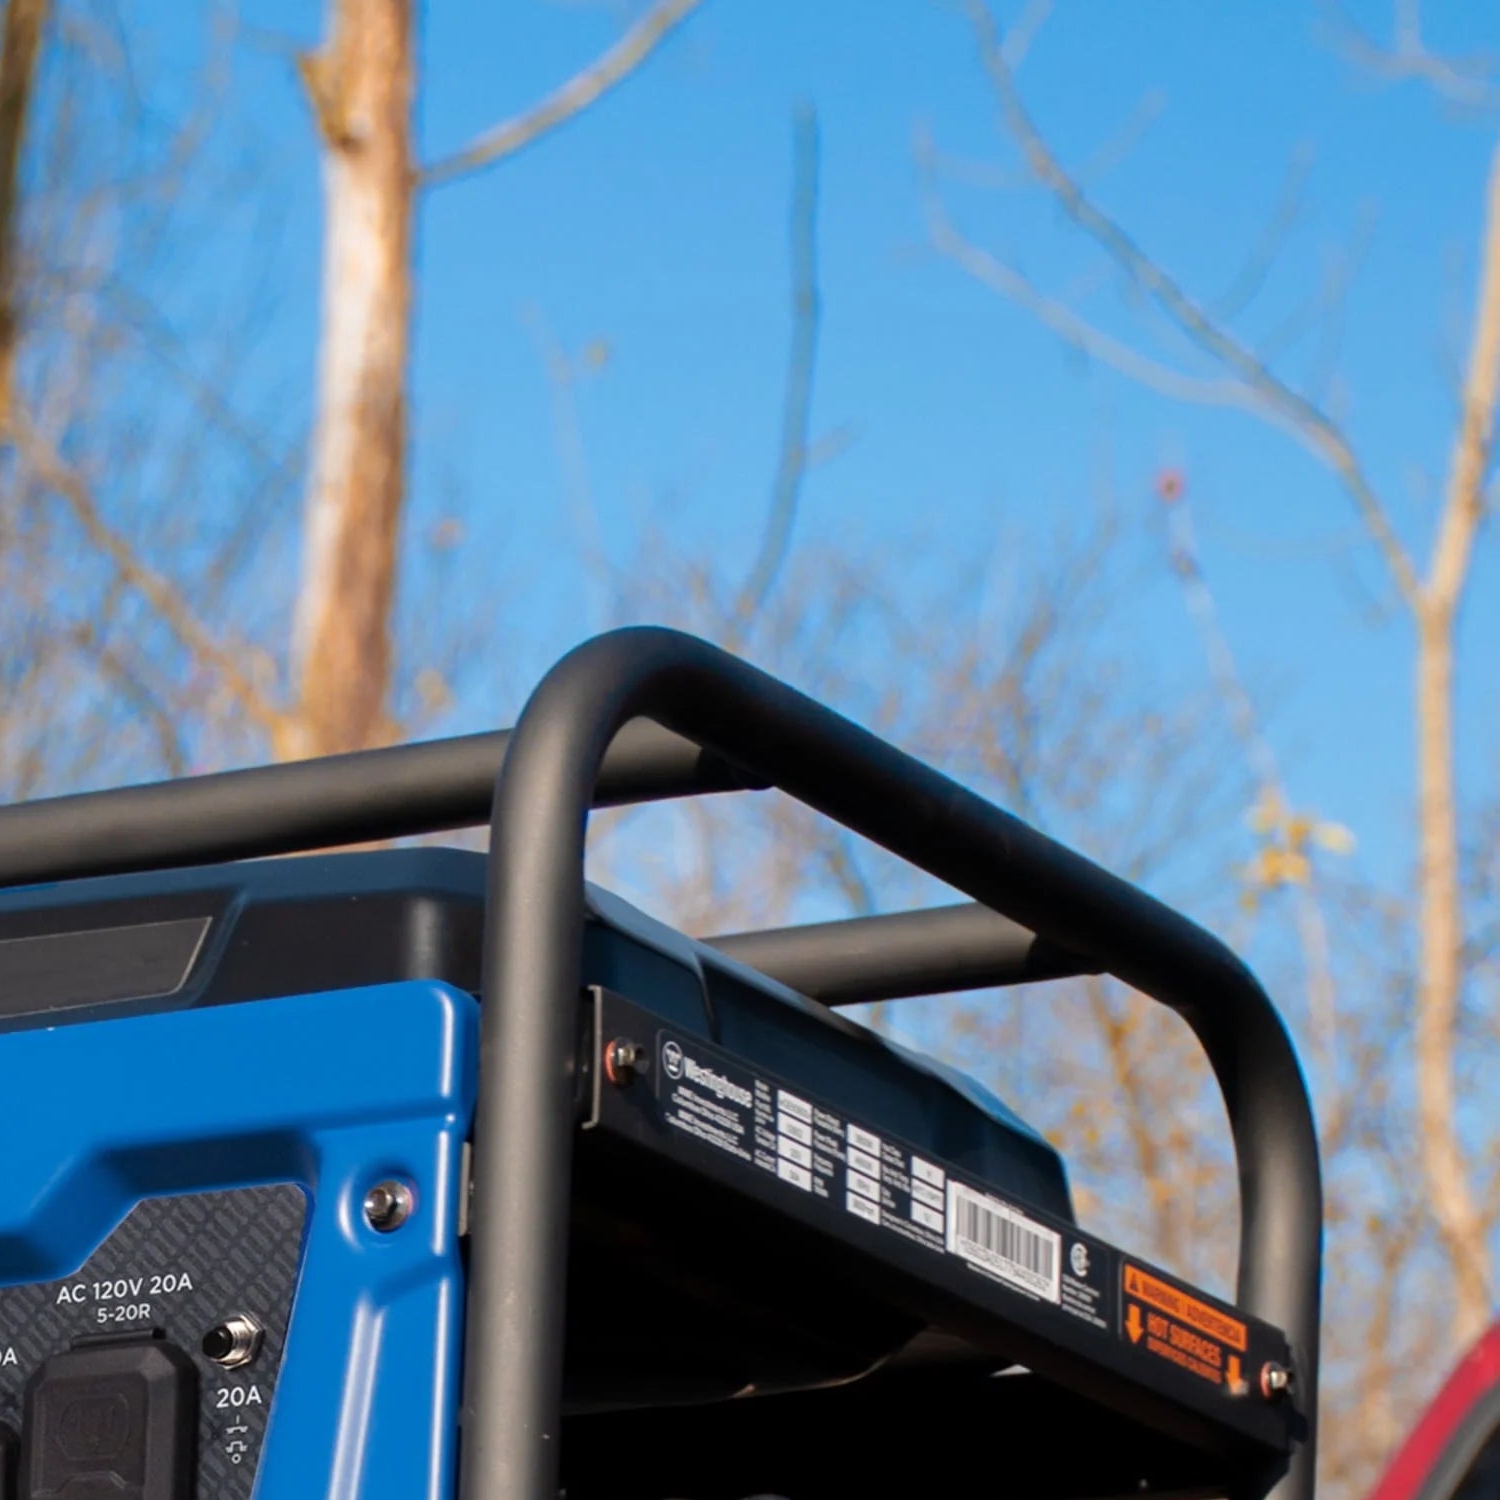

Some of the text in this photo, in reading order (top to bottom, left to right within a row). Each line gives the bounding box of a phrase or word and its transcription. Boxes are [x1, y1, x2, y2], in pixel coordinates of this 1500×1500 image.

[56, 1273, 193, 1305] AC 120V 20A
[96, 1302, 151, 1324] 5-20R
[215, 1386, 263, 1409] 20A
